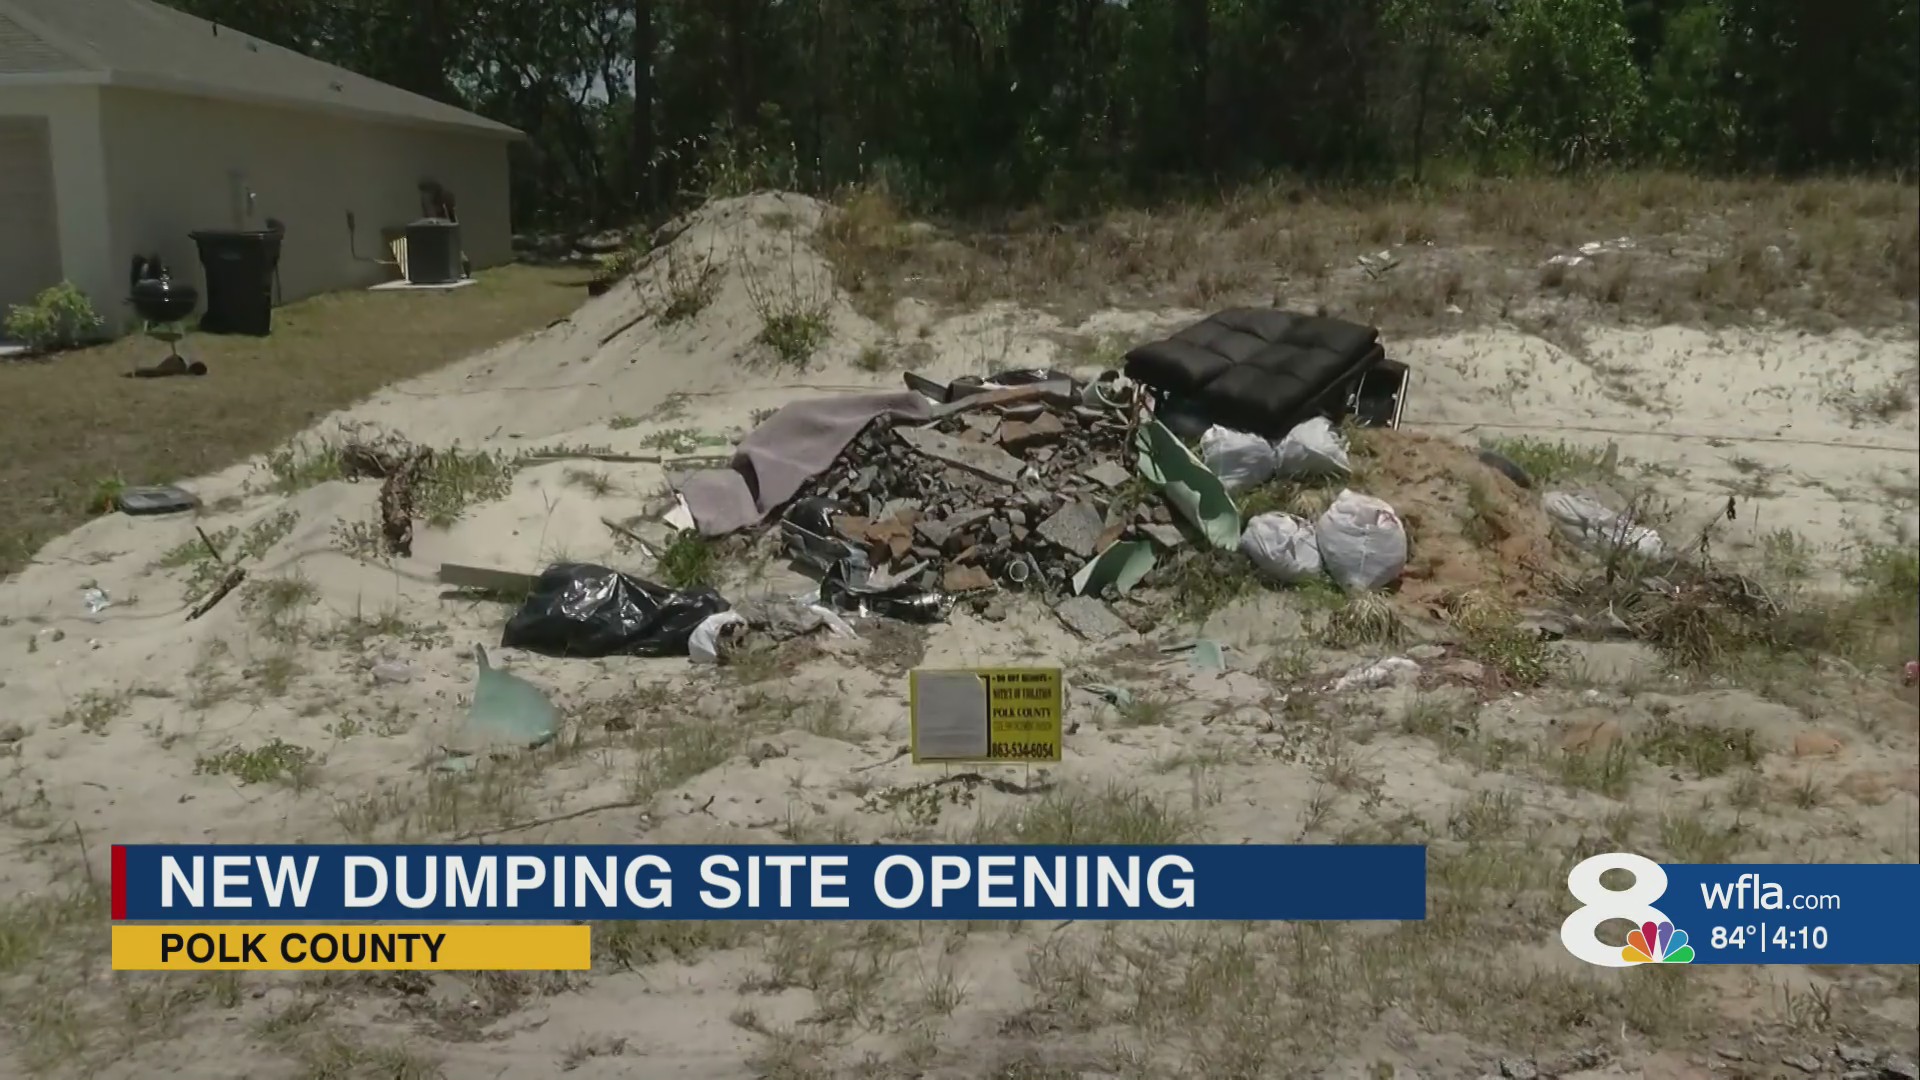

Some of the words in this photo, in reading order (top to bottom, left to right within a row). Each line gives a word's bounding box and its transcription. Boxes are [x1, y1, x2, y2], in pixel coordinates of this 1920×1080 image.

[993, 707, 1015, 718] POLK
[1016, 707, 1051, 718] COUNTY
[992, 742, 1054, 758] 863-534-6054
